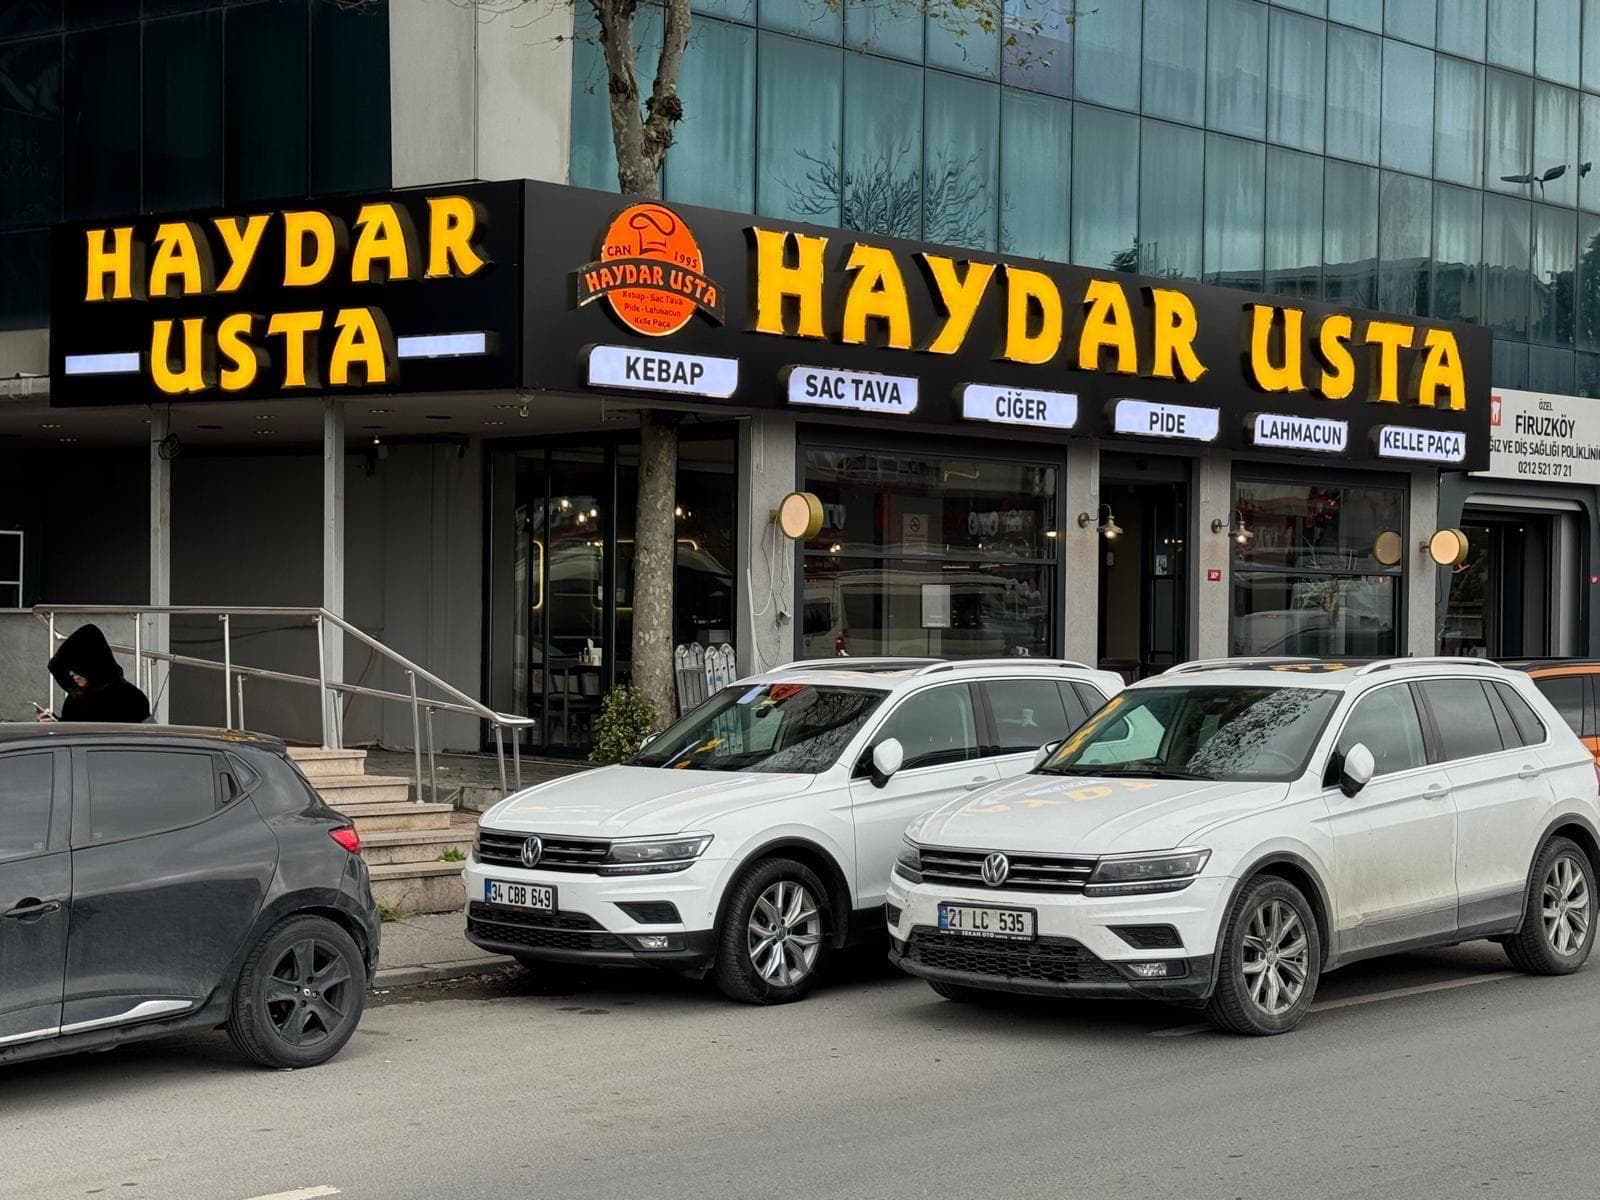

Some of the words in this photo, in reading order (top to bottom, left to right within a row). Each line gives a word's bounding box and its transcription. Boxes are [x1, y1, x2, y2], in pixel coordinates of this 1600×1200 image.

[85, 195, 485, 301] HAYDAR
[607, 245, 631, 256] CAN
[674, 251, 698, 268] 1995
[585, 264, 664, 293] HAYDAR
[669, 269, 717, 308] USTA
[622, 290, 645, 301] Kebap
[650, 293, 665, 303] Sac
[665, 296, 684, 306] Tava
[624, 303, 640, 312] Pide
[645, 306, 681, 318] Lahmacun
[634, 317, 652, 326] Kelle
[653, 320, 671, 329] Paça
[753, 226, 1209, 383] HAYDAR
[1251, 304, 1466, 410] USTA
[151, 306, 387, 394] USTA
[626, 355, 704, 385] KEBAP
[805, 374, 845, 399] SAC
[851, 379, 902, 404] TAVA
[995, 390, 1047, 421] CİĞER
[1539, 398, 1553, 411] ÖZEL
[1149, 406, 1186, 434] PİDE
[1260, 419, 1342, 445] LAHMACUN
[1515, 410, 1575, 439] FİRUZKÖY
[1384, 431, 1424, 452] KELLE
[1428, 435, 1461, 458] PAÇA
[1503, 440, 1513, 454] VE
[1515, 438, 1528, 457] DİŞ
[1529, 440, 1560, 458] SAĞLIĞI
[1561, 443, 1600, 460] POLİKLİNİ
[1518, 461, 1537, 474] 0212
[1538, 463, 1551, 475] 521
[492, 884, 503, 902] 34
[508, 886, 527, 905] CBB
[531, 889, 551, 908] 649
[949, 909, 962, 928] 21
[973, 911, 989, 929] LC
[999, 912, 1024, 932] 535
